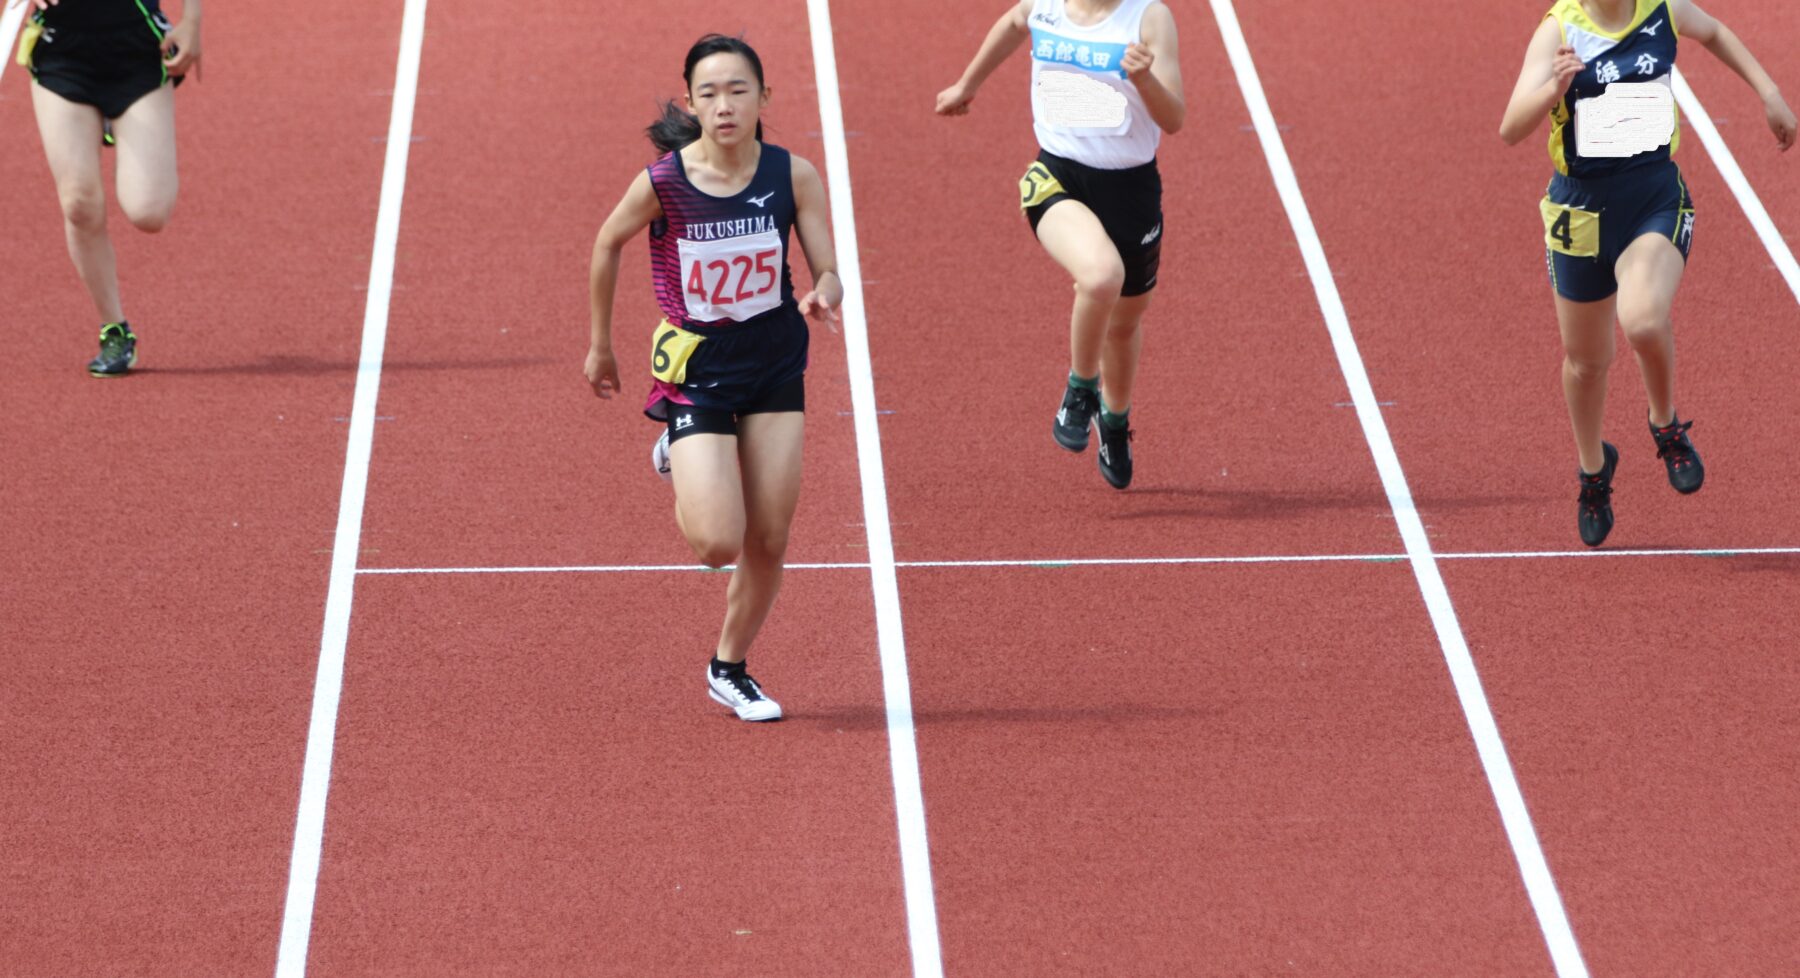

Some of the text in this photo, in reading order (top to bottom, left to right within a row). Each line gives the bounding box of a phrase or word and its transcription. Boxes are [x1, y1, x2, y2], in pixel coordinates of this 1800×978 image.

[1023, 166, 1050, 203] 5
[686, 215, 778, 240] FUKUSHIMA
[1551, 209, 1573, 250] 4
[687, 249, 777, 305] 4225
[653, 329, 678, 373] 6
